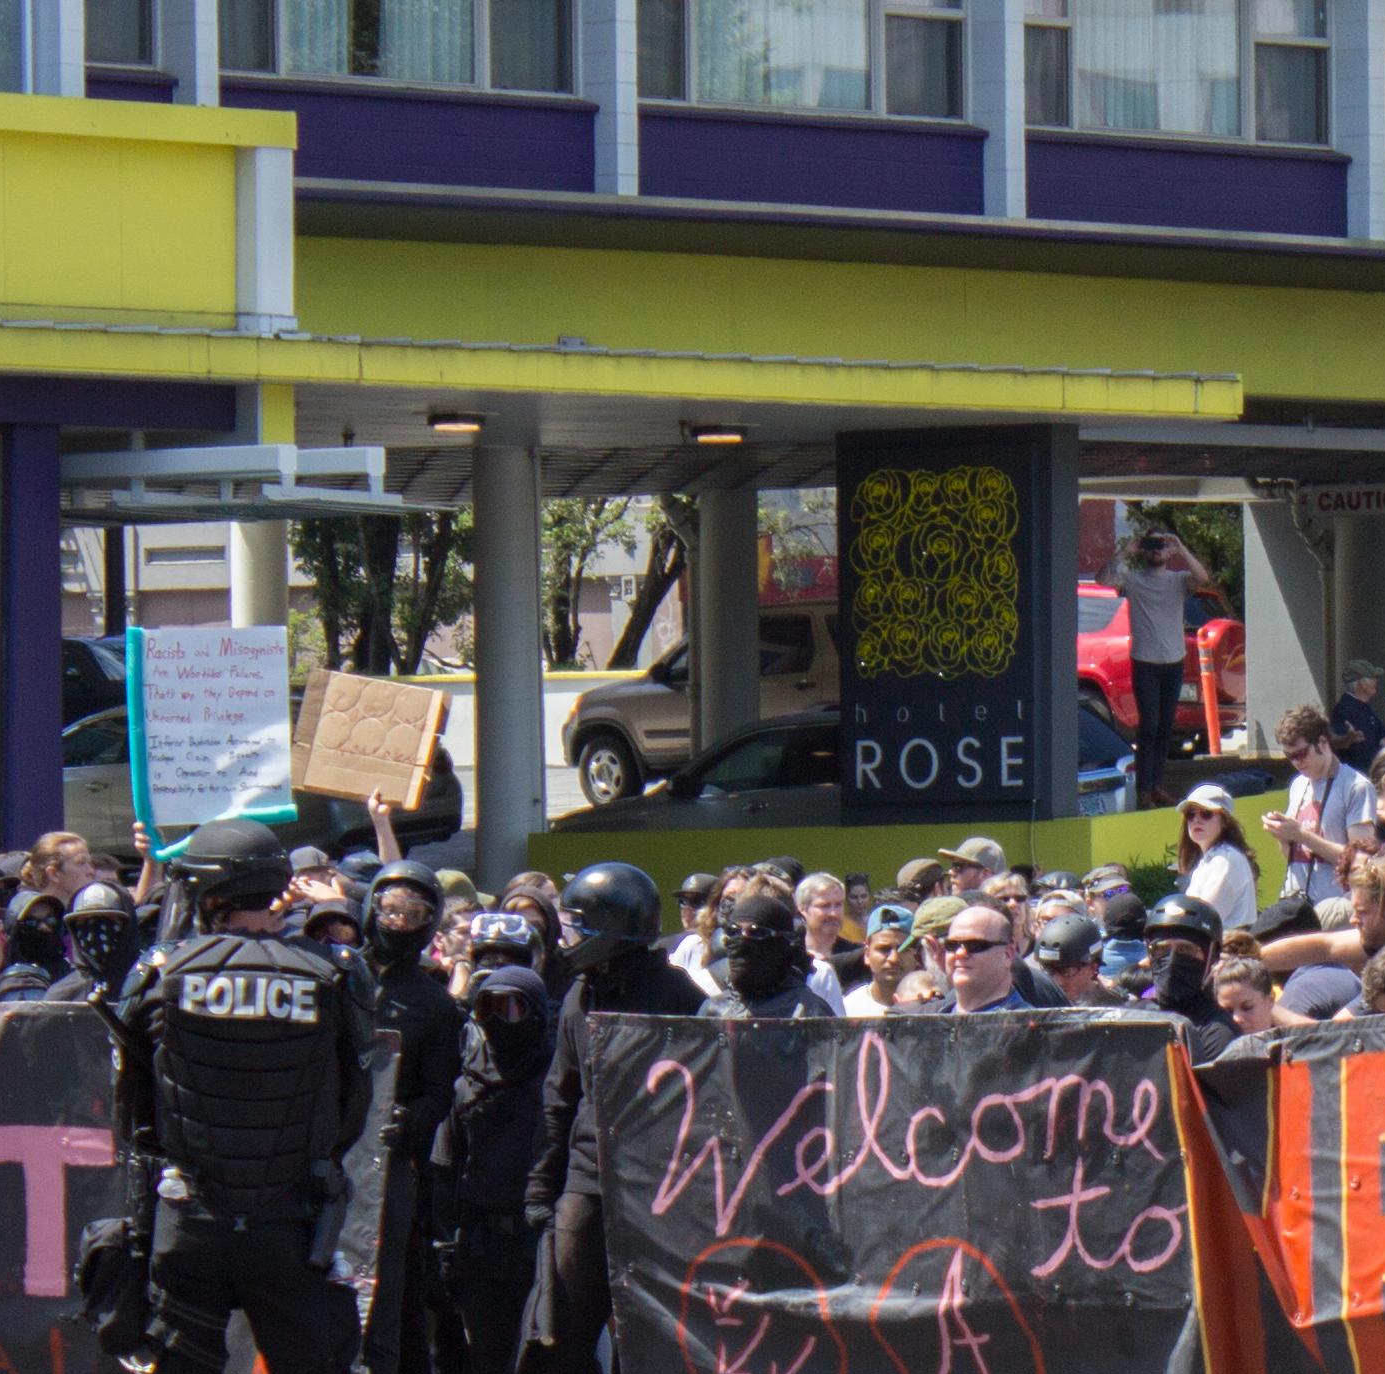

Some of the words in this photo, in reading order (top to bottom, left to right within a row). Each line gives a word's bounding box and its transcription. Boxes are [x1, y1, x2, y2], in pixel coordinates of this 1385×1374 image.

[146, 637, 186, 660] Racists
[194, 645, 210, 658] and
[219, 637, 286, 661] Misogynists
[152, 664, 169, 678] Are
[203, 687, 223, 702] they
[228, 685, 259, 701] Depend
[855, 699, 1023, 723] hotel
[855, 736, 1024, 790] ROSE
[180, 973, 318, 1024] POLICE
[646, 1030, 1165, 1238] Welcome
[1029, 1155, 1190, 1279] to
